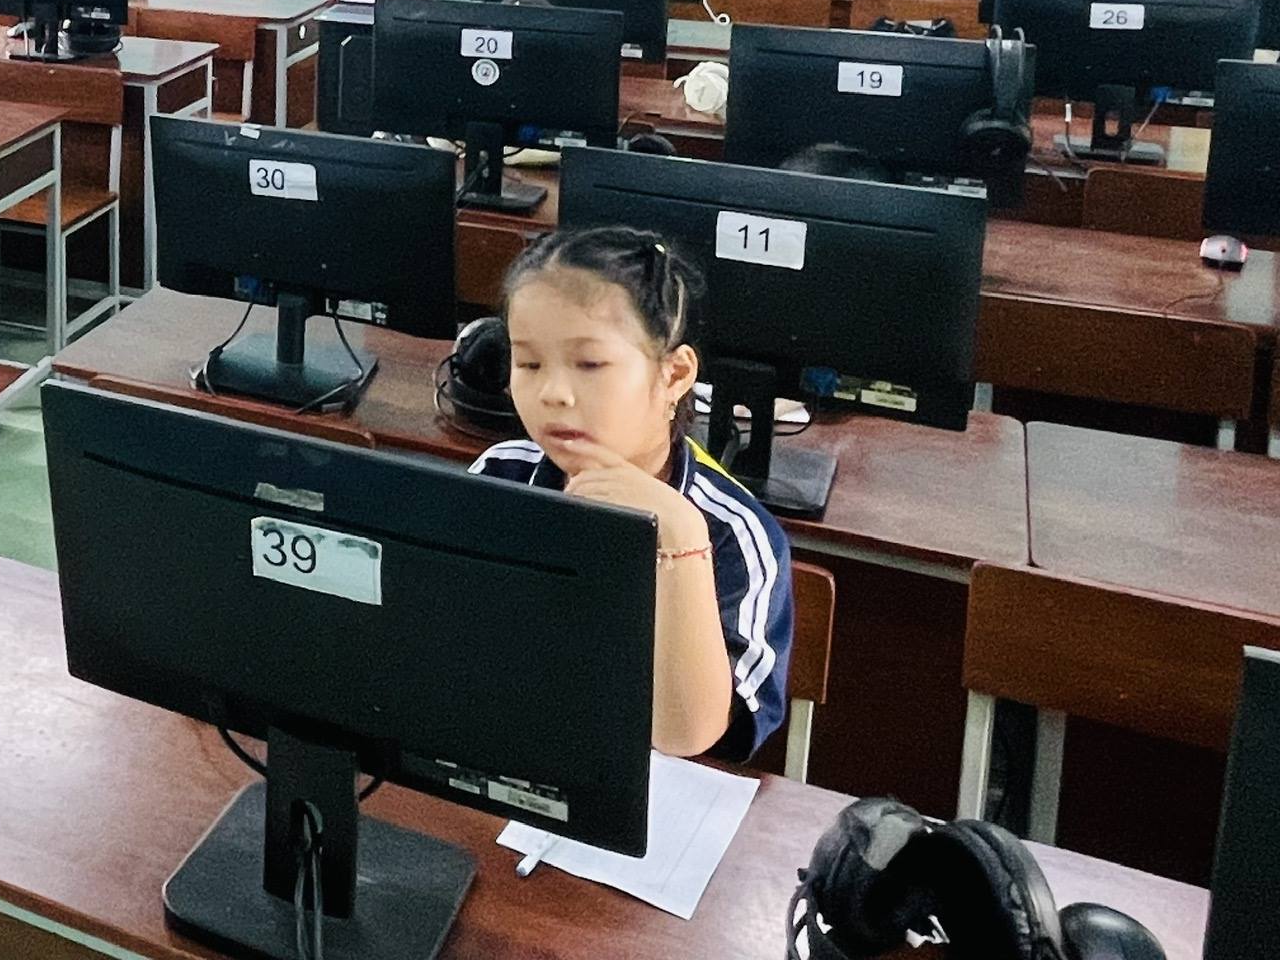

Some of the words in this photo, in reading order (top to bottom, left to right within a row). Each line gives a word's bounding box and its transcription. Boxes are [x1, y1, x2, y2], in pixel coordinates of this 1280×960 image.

[1102, 10, 1128, 25] 26
[474, 36, 498, 54] 20
[856, 70, 882, 89] 19
[256, 167, 285, 191] 30
[738, 224, 770, 252] 11
[262, 527, 317, 574] 39
